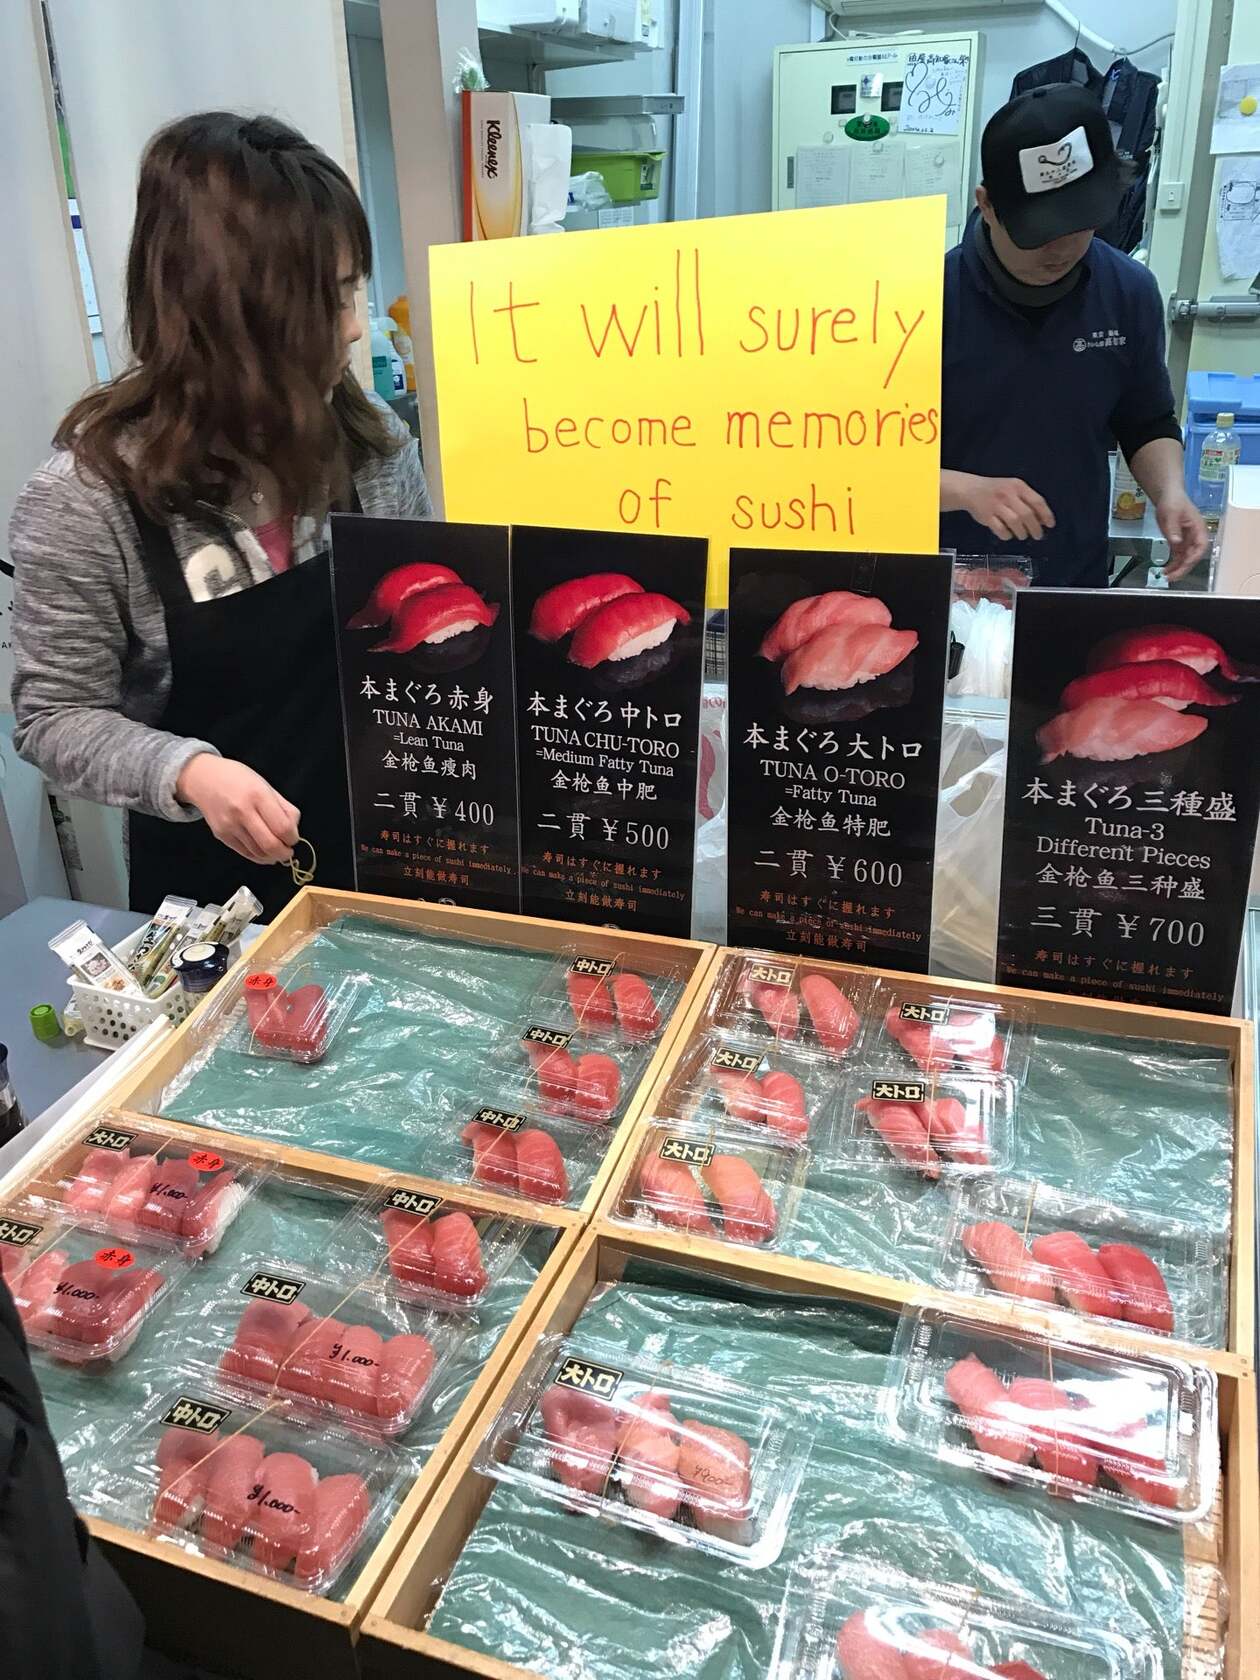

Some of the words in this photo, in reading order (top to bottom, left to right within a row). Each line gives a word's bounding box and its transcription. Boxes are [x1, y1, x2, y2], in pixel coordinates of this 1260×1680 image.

[484, 119, 502, 179] Kleenex
[470, 281, 540, 365] It
[581, 248, 704, 358] will
[740, 280, 925, 389] surely
[523, 398, 697, 453] become
[726, 403, 939, 449] memories
[619, 479, 672, 528] of
[731, 484, 856, 535] sushi
[359, 674, 494, 715] 本まぐろ赤身
[526, 690, 682, 729] 本まぐろ中トロ
[372, 709, 421, 729] TUNA
[425, 715, 484, 736] AKAMI
[393, 732, 429, 747] =Lean
[431, 736, 465, 752] Tuna
[531, 725, 582, 746] TUNA
[584, 732, 680, 759] CHU-TORO
[743, 722, 923, 760] 本まぐろ大トロ
[382, 750, 477, 780] 金枪鱼瘦肉
[535, 747, 595, 766] =Medium
[599, 754, 635, 773] Fatty
[639, 760, 675, 777] Tuna
[760, 759, 818, 781] TUNA
[824, 766, 906, 790] O-TORO
[550, 769, 658, 801] 金枪鱼中肥
[784, 784, 833, 804] =Fatty
[837, 789, 877, 807] Tuna
[1022, 776, 1237, 822] 本まぐろ三種盛
[431, 796, 494, 826] ¥400
[769, 805, 892, 837] 金枪鱼特肥
[380, 829, 490, 855] 寿司はすぐに握れます
[602, 817, 670, 850] ¥500
[1085, 817, 1165, 841] Tuna-3
[372, 846, 384, 854] can
[386, 849, 401, 857] make
[412, 852, 432, 862] piece
[434, 855, 442, 863] of
[446, 857, 465, 866] sushi
[543, 850, 663, 880] 寿司はすぐに握れます
[1036, 836, 1135, 862] Different
[1141, 846, 1212, 869] Pieces
[533, 868, 546, 877] can
[548, 871, 566, 881] make
[576, 875, 598, 886] piece
[601, 879, 609, 888] of
[613, 882, 634, 892] sushi
[639, 885, 685, 901] immediately
[826, 854, 903, 888] ¥600
[760, 889, 896, 919] 寿司はすぐに握れます
[749, 910, 763, 918] can
[767, 911, 786, 922] make
[799, 915, 822, 927] piece
[826, 918, 835, 928] of
[839, 920, 863, 932] sushi
[867, 926, 922, 943] immediately
[1117, 913, 1205, 947] ¥700
[574, 958, 613, 975] 中トロ
[750, 965, 793, 985] 大トロ
[1034, 949, 1195, 980] 寿司はすぐに握れます
[1021, 968, 1039, 978] can
[1043, 971, 1065, 981] make
[1080, 976, 1108, 987] piece
[1112, 979, 1124, 989] of
[1128, 982, 1157, 994] sushi
[1161, 986, 1225, 1003] immediately
[903, 1004, 947, 1022] 大トロ
[529, 1028, 570, 1046] 中トロ
[715, 1050, 760, 1070] 大トロ
[875, 1083, 922, 1100] 大トロ
[479, 1109, 521, 1130] 中トロ
[88, 1130, 132, 1149] 大トロ
[662, 1139, 712, 1163] 大トロ
[390, 1193, 435, 1214] 中トロ
[250, 1277, 298, 1300] 中トロ
[559, 1363, 617, 1394] 大トロ
[171, 1403, 223, 1430] 中トロ
